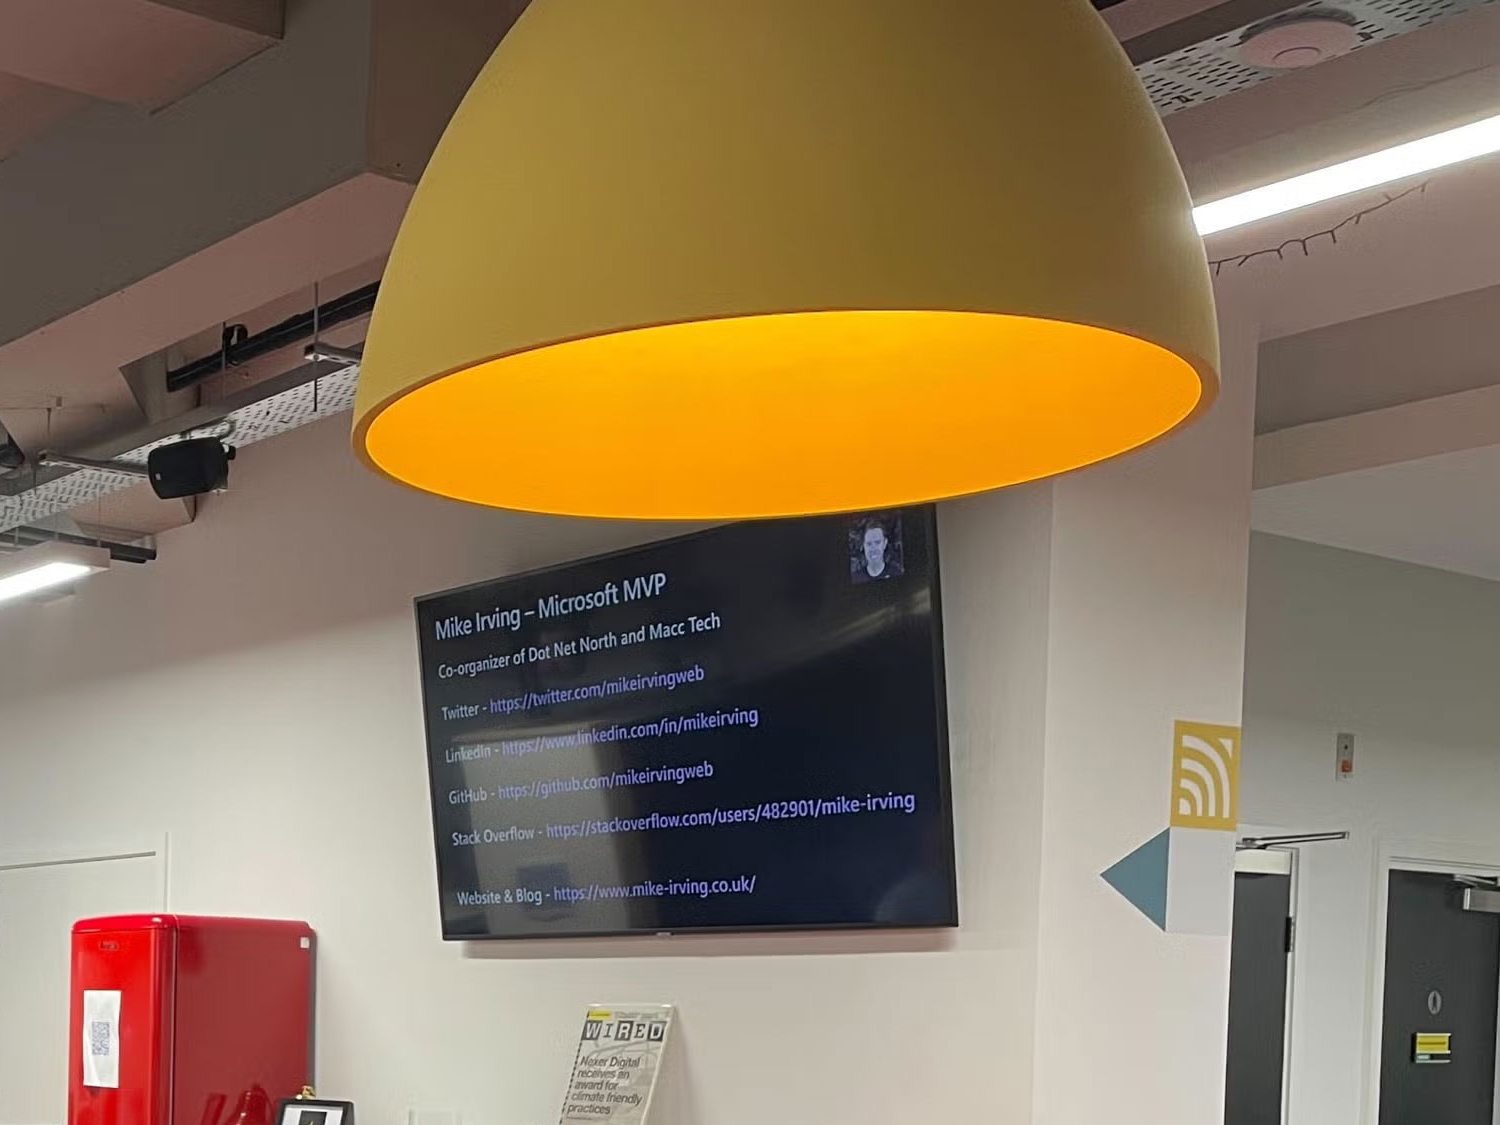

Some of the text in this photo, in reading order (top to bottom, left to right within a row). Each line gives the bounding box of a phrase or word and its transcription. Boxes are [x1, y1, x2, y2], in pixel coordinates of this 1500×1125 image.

[435, 617, 472, 641] Mike
[476, 607, 521, 634] Irving
[538, 583, 619, 620] Microsoft
[623, 573, 667, 601] MVP
[438, 611, 722, 678] Co-organizer of Dot Net North and Macc Tech
[441, 703, 479, 721] Twitter
[490, 664, 705, 714] https://twitter.com/mikeirvingweb
[445, 744, 491, 764] LinkedIn
[502, 707, 759, 757] https://www.linkedin.com/in/mikeirving
[449, 786, 488, 804] GitHub
[498, 760, 714, 800] https://github.com/mikeirvingweb
[452, 829, 482, 847] Stack
[483, 825, 535, 844] Overflow
[546, 792, 916, 838] https://stackoverflow.com/users/482901/mike-irving
[456, 890, 500, 906] Website
[504, 889, 513, 903] &
[516, 887, 543, 906] Blog
[554, 875, 756, 904] https://www.mike-irving.co.uk/
[581, 1020, 668, 1042] WIRED
[577, 1069, 630, 1080] receives an
[580, 1056, 641, 1069] Nexer Digital
[571, 1092, 643, 1107] climate friendly
[574, 1080, 618, 1091] award for
[566, 1104, 611, 1115] practices
